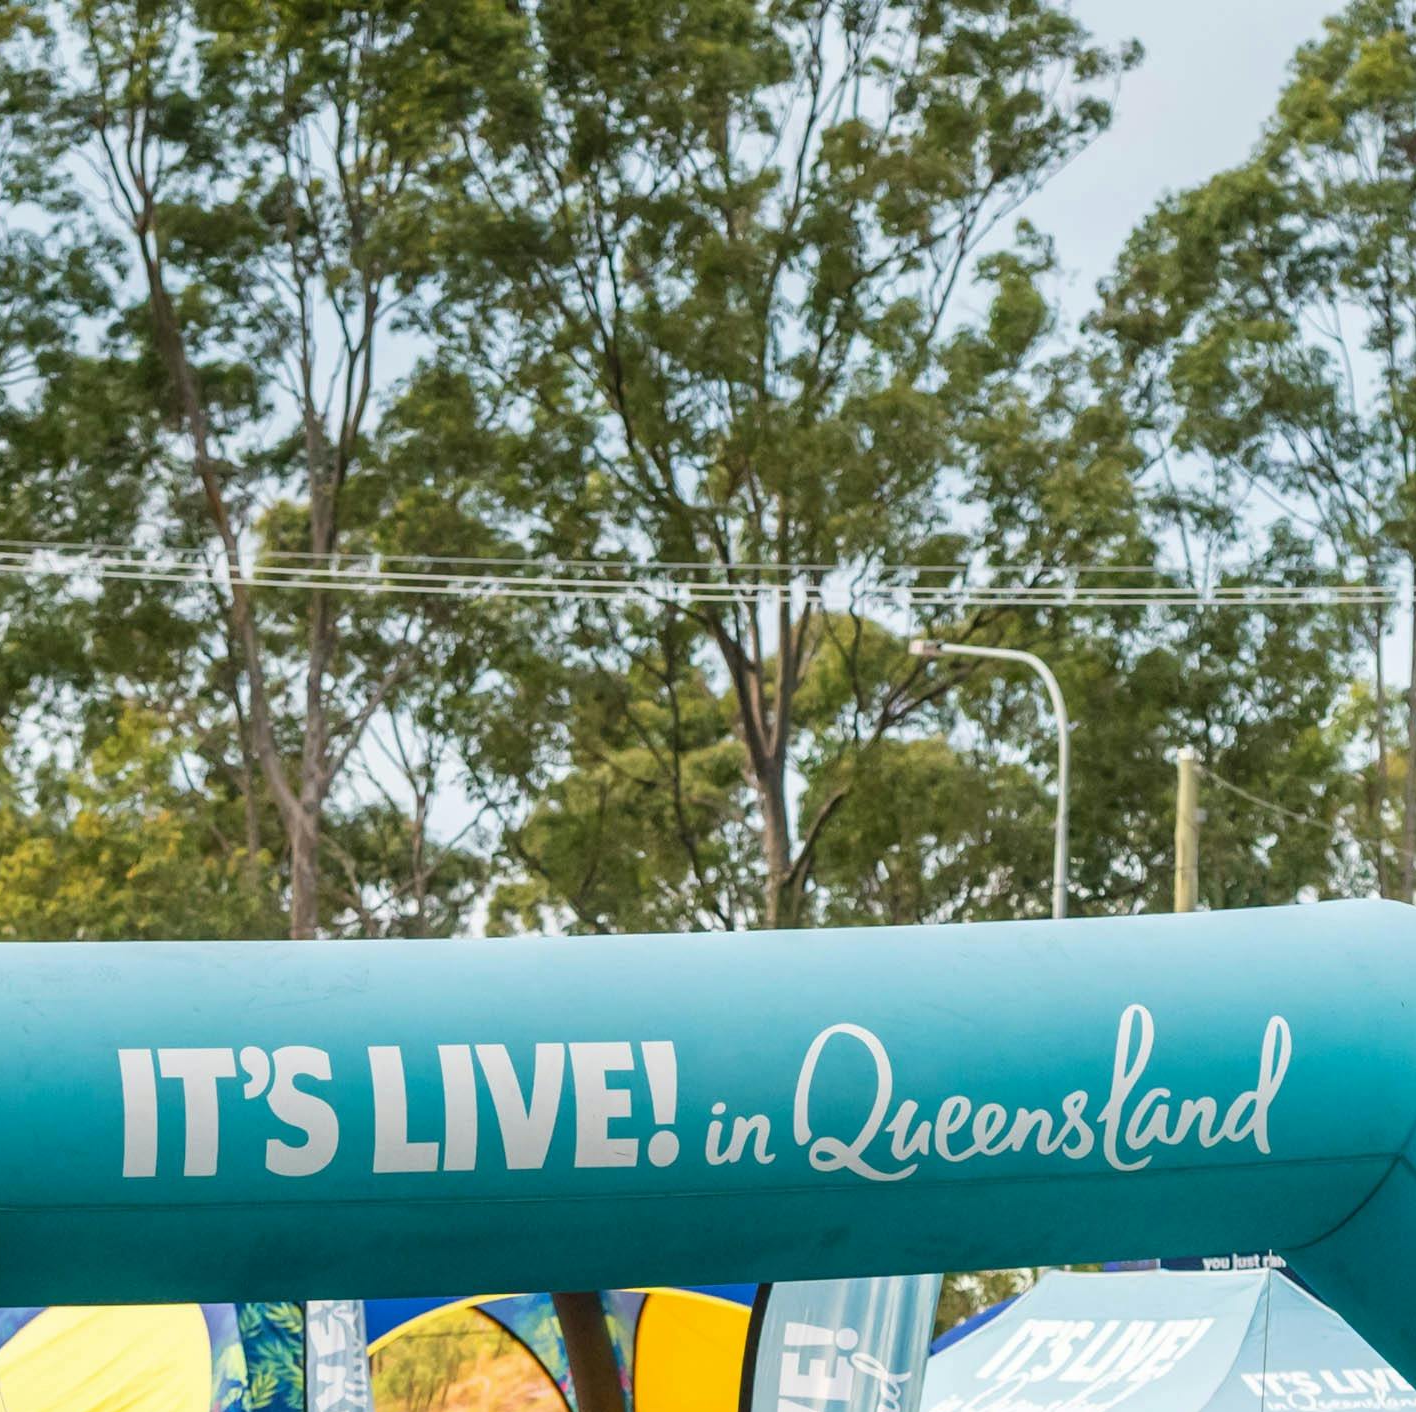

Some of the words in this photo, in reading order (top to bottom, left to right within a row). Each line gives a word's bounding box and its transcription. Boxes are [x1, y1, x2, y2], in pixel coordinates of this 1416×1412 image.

[118, 1044, 339, 1178] IT'S
[370, 1040, 680, 1174] LIVE!
[705, 1102, 773, 1166] in
[793, 1003, 1292, 1181] Queensland
[1240, 1369, 1322, 1398] IT'S
